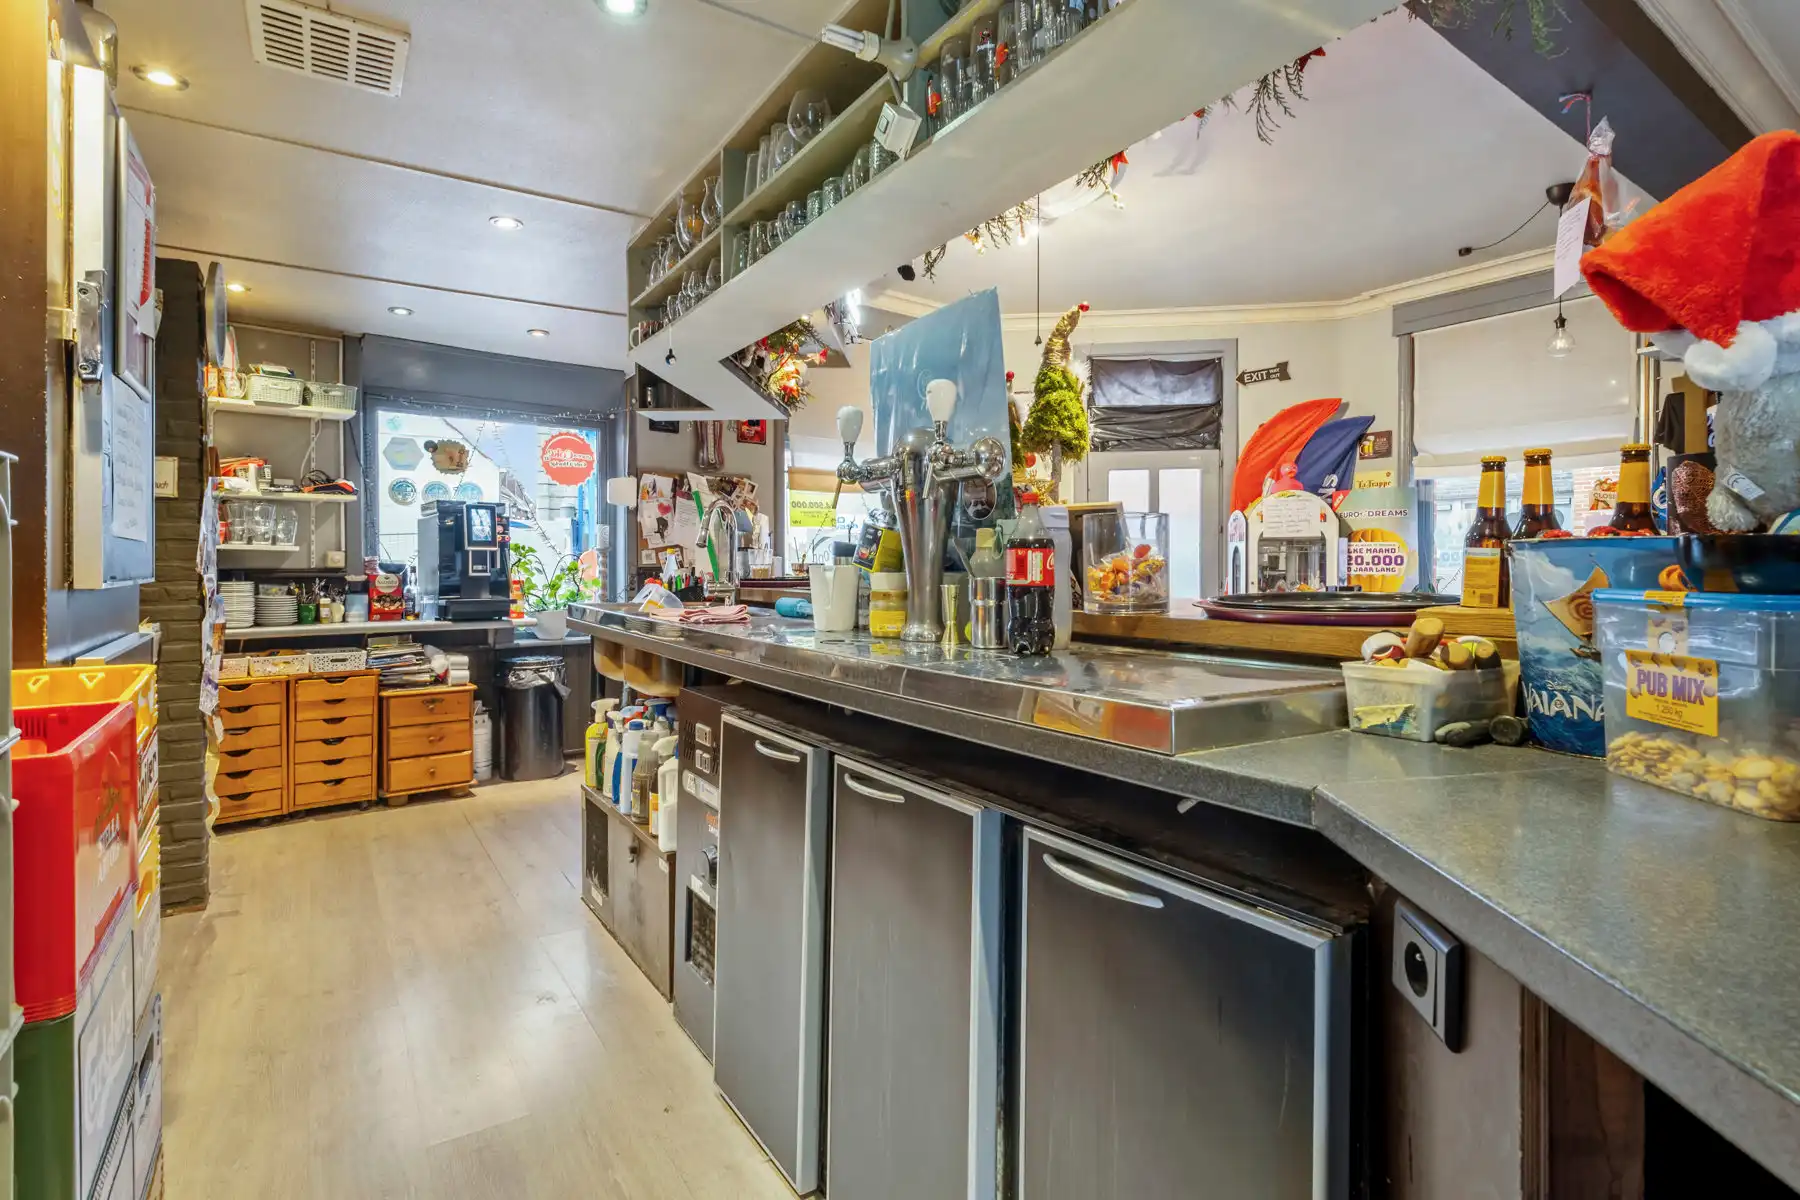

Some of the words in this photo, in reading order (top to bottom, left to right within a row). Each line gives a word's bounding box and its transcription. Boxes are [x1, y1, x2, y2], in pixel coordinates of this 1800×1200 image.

[1244, 371, 1268, 383] EXIT
[1368, 479, 1391, 489] Trappe
[1593, 492, 1617, 500] CLOSE
[1339, 511, 1360, 519] EURO
[1367, 509, 1408, 517] DREAMS
[1636, 668, 1668, 698] PUB
[1671, 674, 1705, 706] MIX
